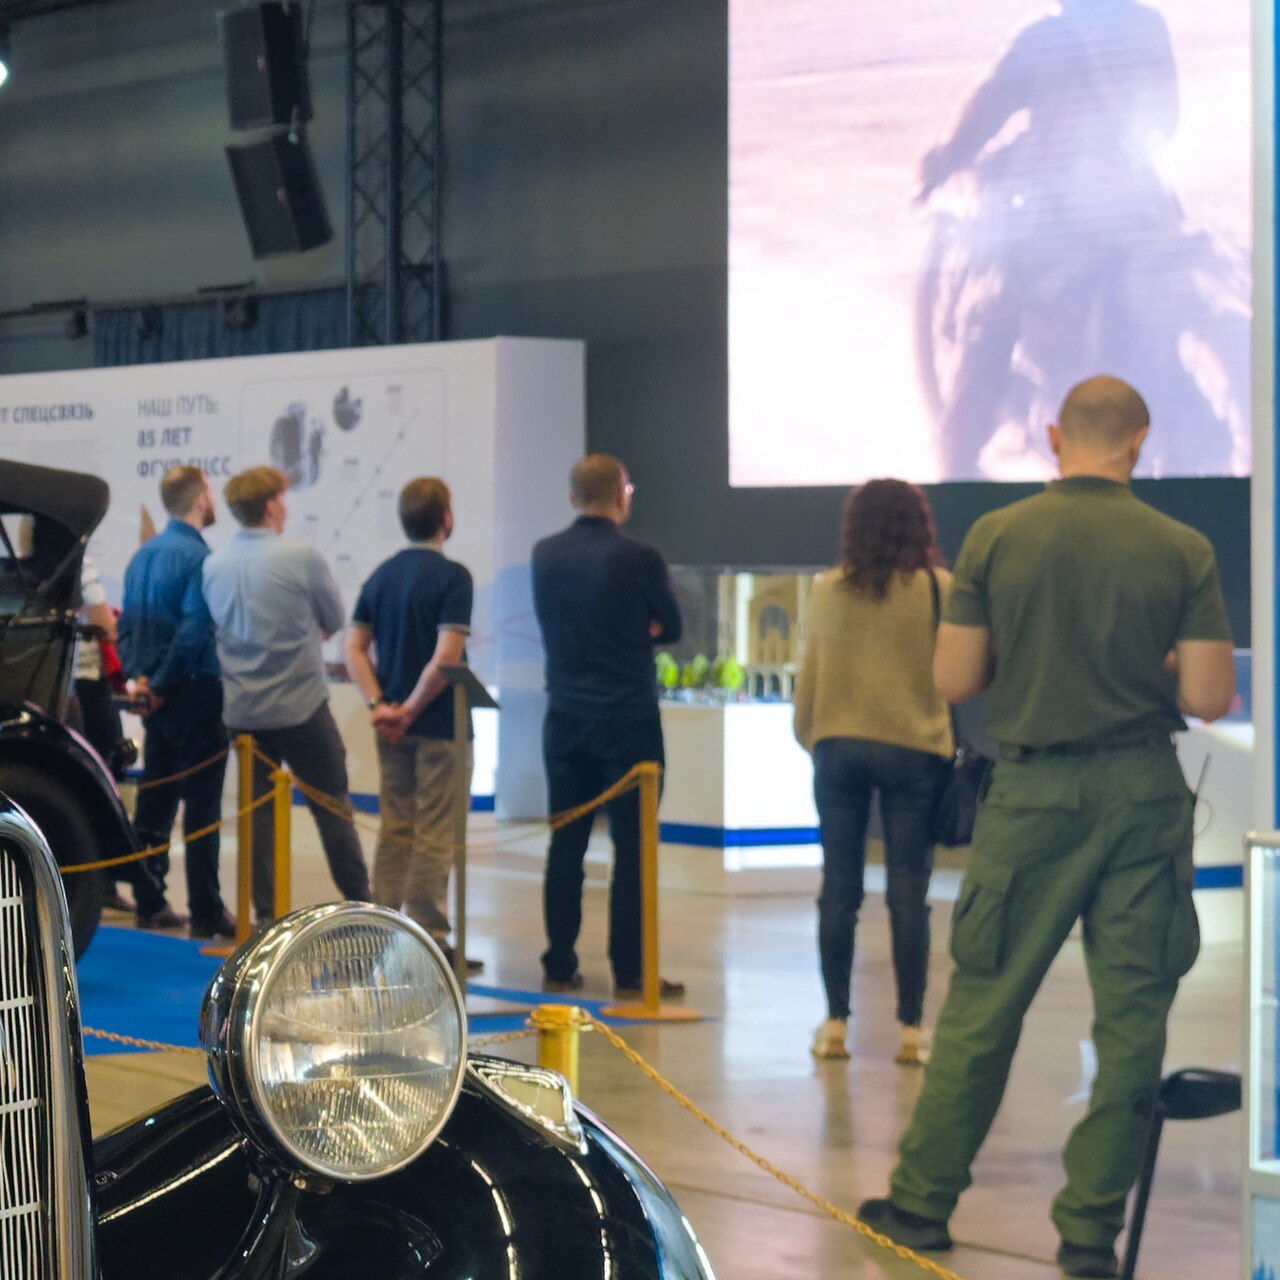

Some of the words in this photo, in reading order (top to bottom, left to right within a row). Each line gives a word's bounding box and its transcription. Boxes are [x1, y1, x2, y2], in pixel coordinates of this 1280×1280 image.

[12, 402, 94, 426] СПЕЦСВЯЗЬ
[137, 397, 172, 418] НАШ
[160, 426, 193, 448] ЛЕТ
